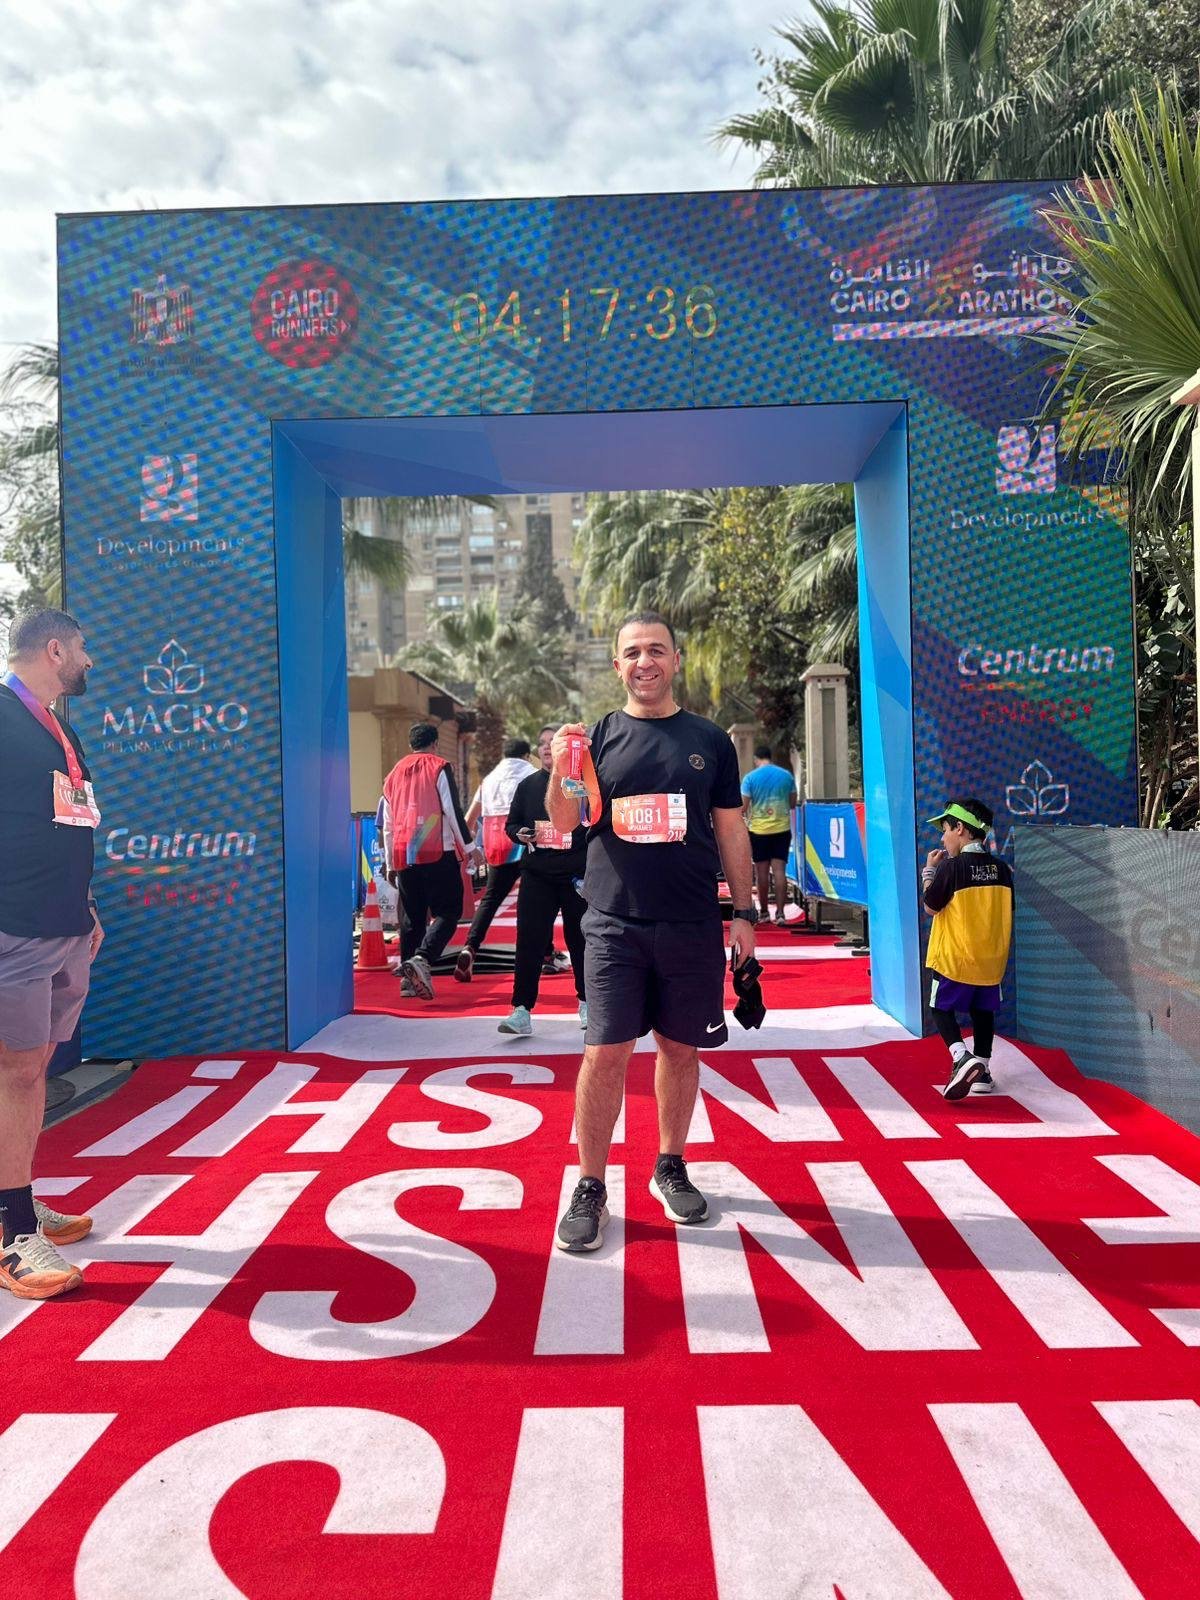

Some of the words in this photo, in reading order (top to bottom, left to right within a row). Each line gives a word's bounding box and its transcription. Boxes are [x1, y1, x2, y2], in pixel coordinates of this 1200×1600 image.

[829, 258, 931, 289] القاهرة
[271, 288, 339, 318] CAIRO
[452, 285, 718, 346] 04:17:36
[830, 289, 911, 314] CAIRO
[271, 318, 339, 338] RUNNERS
[951, 507, 1104, 531] Developments
[97, 535, 245, 556] Developments
[957, 643, 1115, 676] Centrum
[102, 702, 249, 735] MACRO
[105, 827, 257, 861] Centrum
